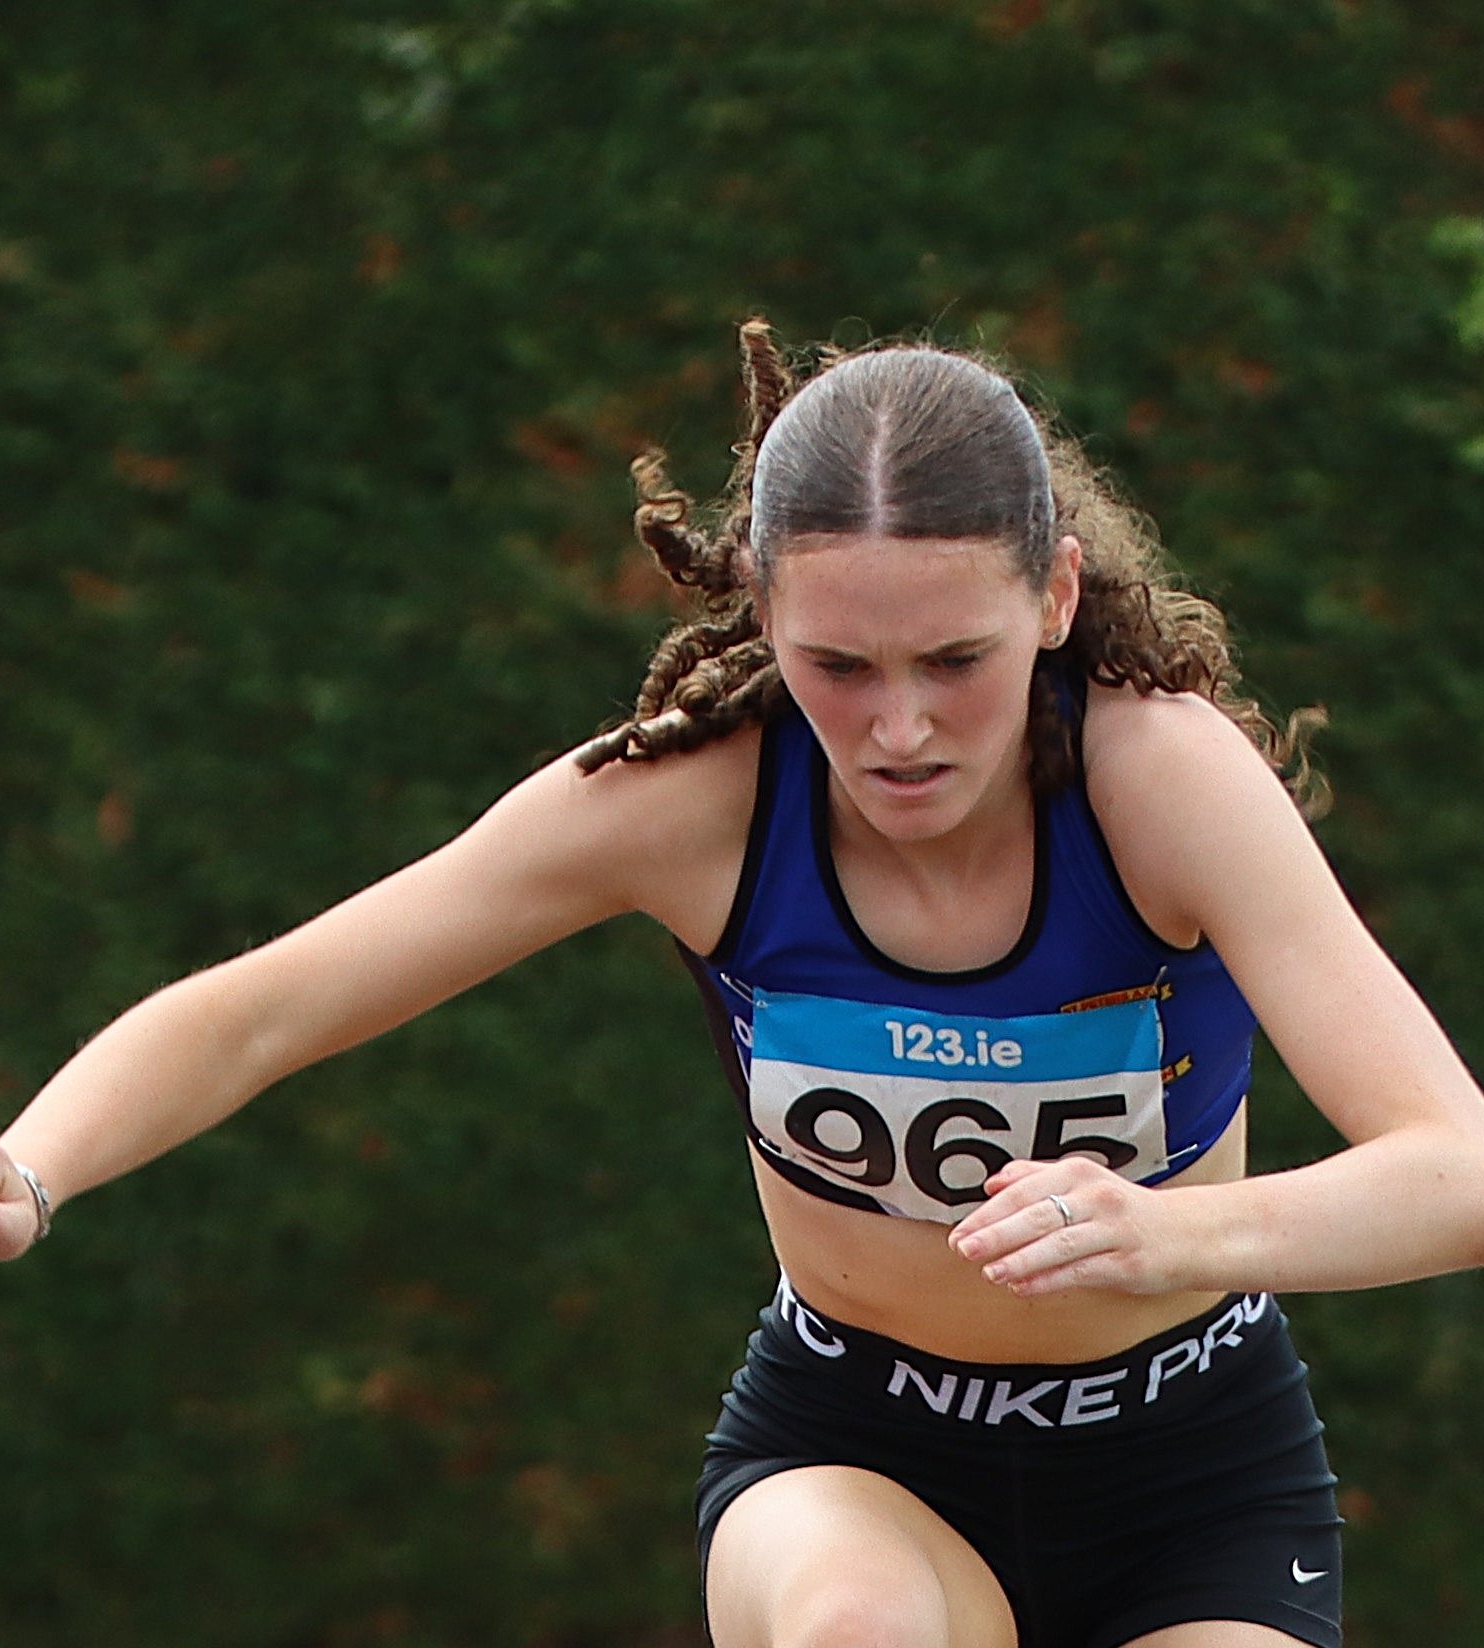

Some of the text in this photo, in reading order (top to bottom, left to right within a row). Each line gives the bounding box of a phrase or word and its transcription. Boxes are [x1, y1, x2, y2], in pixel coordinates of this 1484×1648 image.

[885, 1020, 1022, 1067] 123.ie
[784, 1087, 1139, 1207] 965
[886, 1359, 1130, 1427] NIKE
